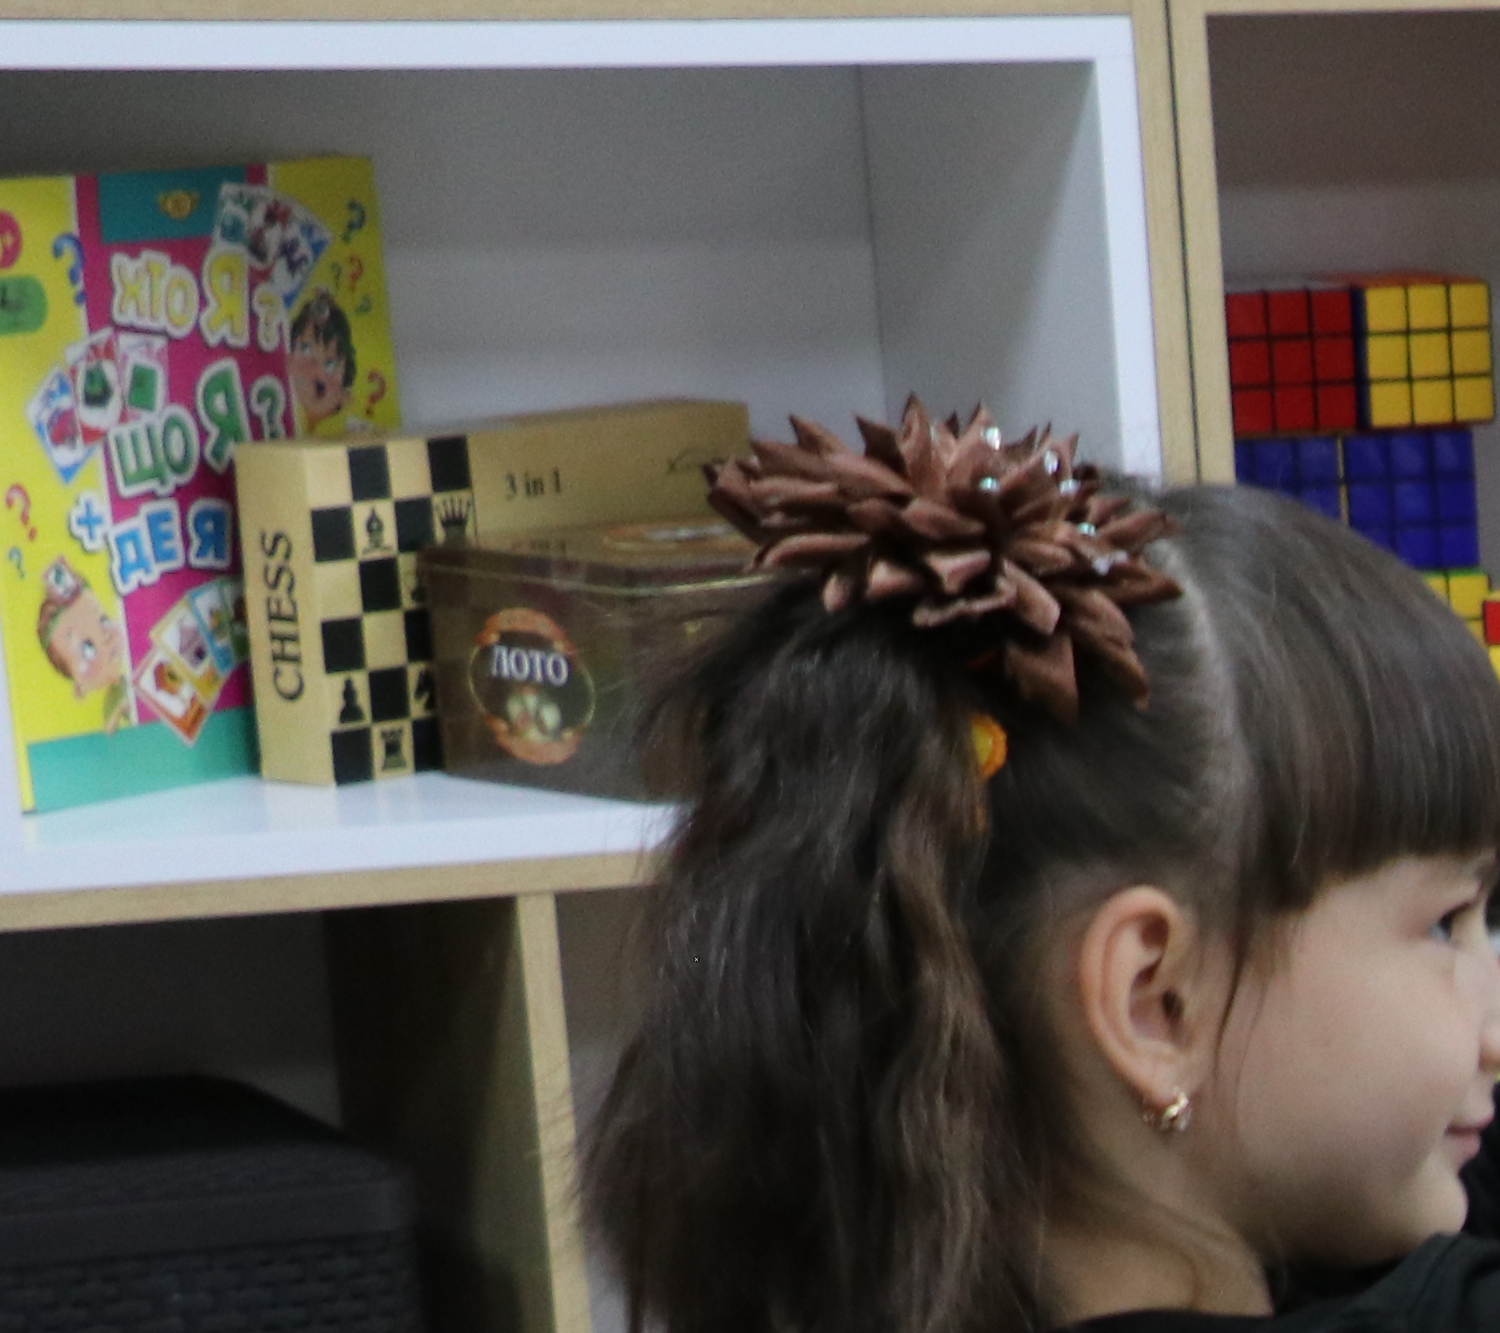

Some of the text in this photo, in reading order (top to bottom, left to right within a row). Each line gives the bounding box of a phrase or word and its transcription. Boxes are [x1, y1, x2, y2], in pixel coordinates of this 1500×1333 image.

[116, 254, 194, 331] ХТО
[114, 412, 194, 487] ЩО
[506, 473, 517, 496] 3
[526, 470, 546, 495] in
[261, 530, 305, 700] CHESS
[489, 645, 570, 686] ЛОТО
